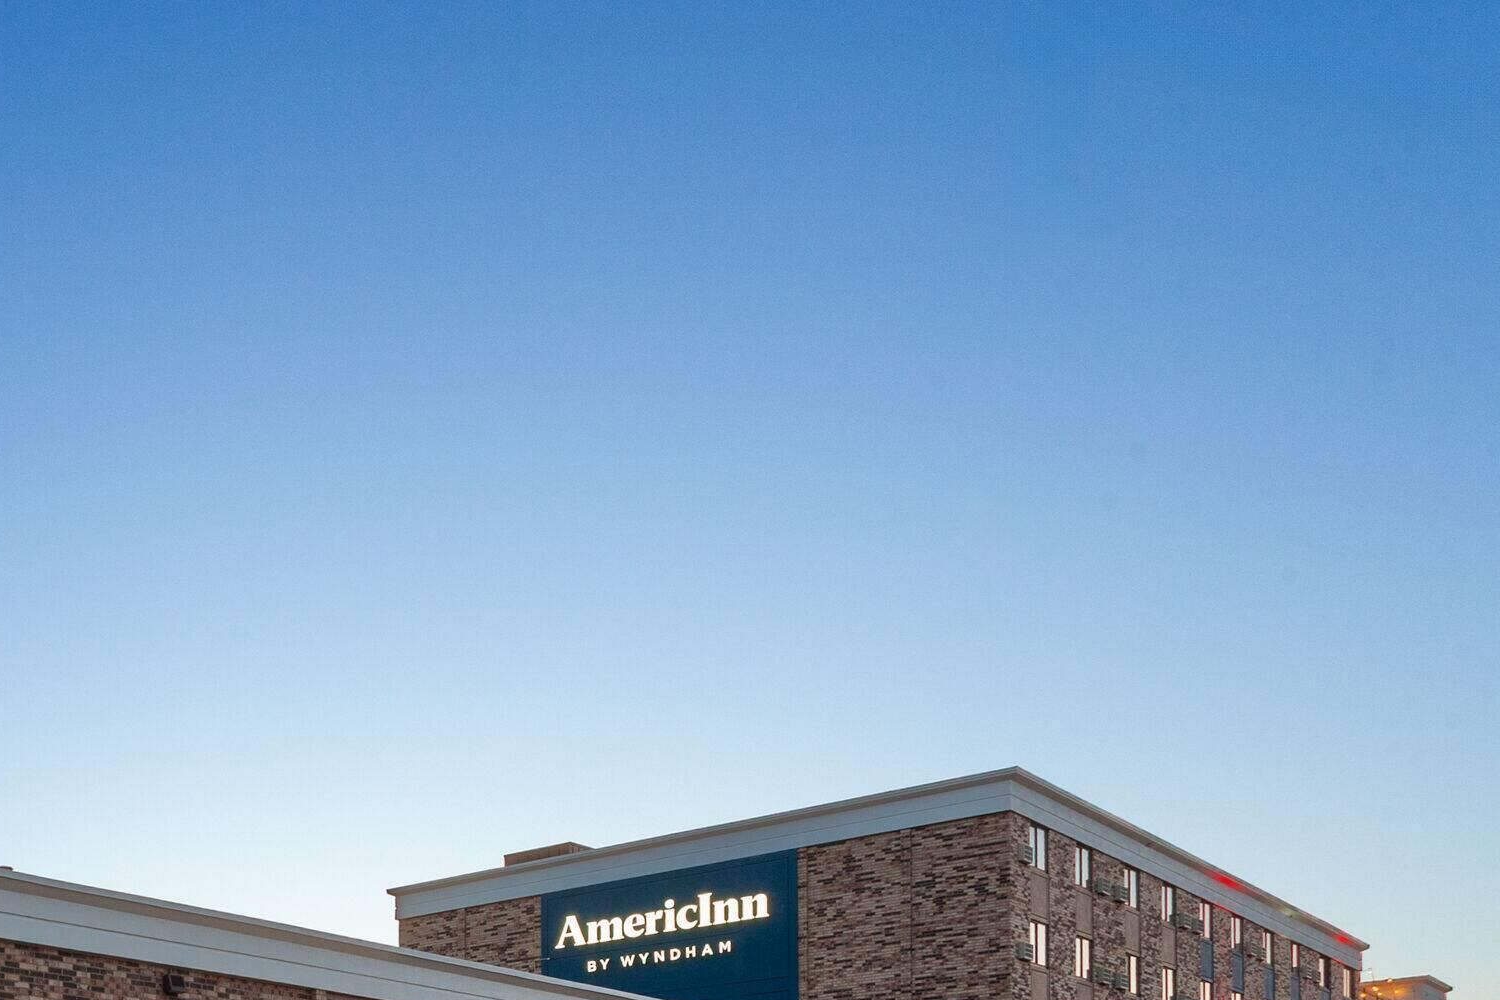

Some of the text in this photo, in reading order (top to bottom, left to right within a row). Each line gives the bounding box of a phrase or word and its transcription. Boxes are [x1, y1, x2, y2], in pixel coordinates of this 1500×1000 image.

[554, 892, 770, 950] AmericInn
[587, 941, 732, 973] BY WYNDHAM
